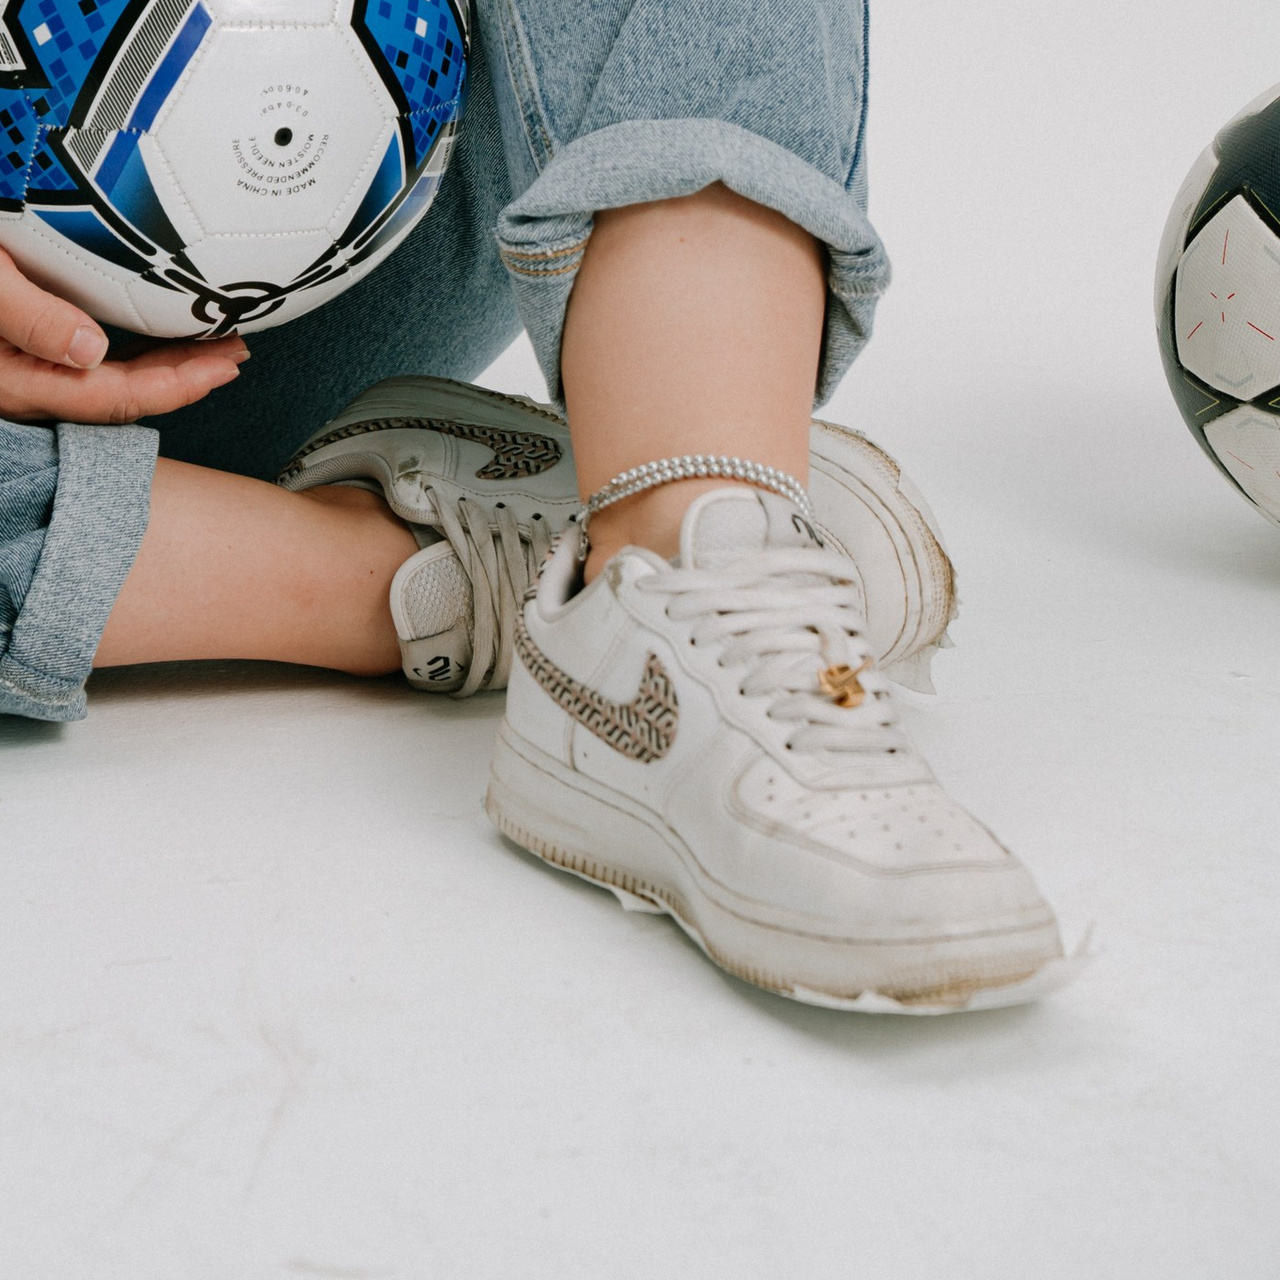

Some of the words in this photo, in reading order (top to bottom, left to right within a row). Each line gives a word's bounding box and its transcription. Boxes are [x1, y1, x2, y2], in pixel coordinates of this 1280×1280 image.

[232, 139, 265, 181] PRESSURE
[248, 136, 276, 168] NEEDLE
[265, 134, 329, 184] RECOMMENDED
[279, 134, 315, 168] MOISTEN
[236, 179, 268, 197] CHINA
[271, 189, 282, 197] IN
[285, 177, 317, 196] MADE
